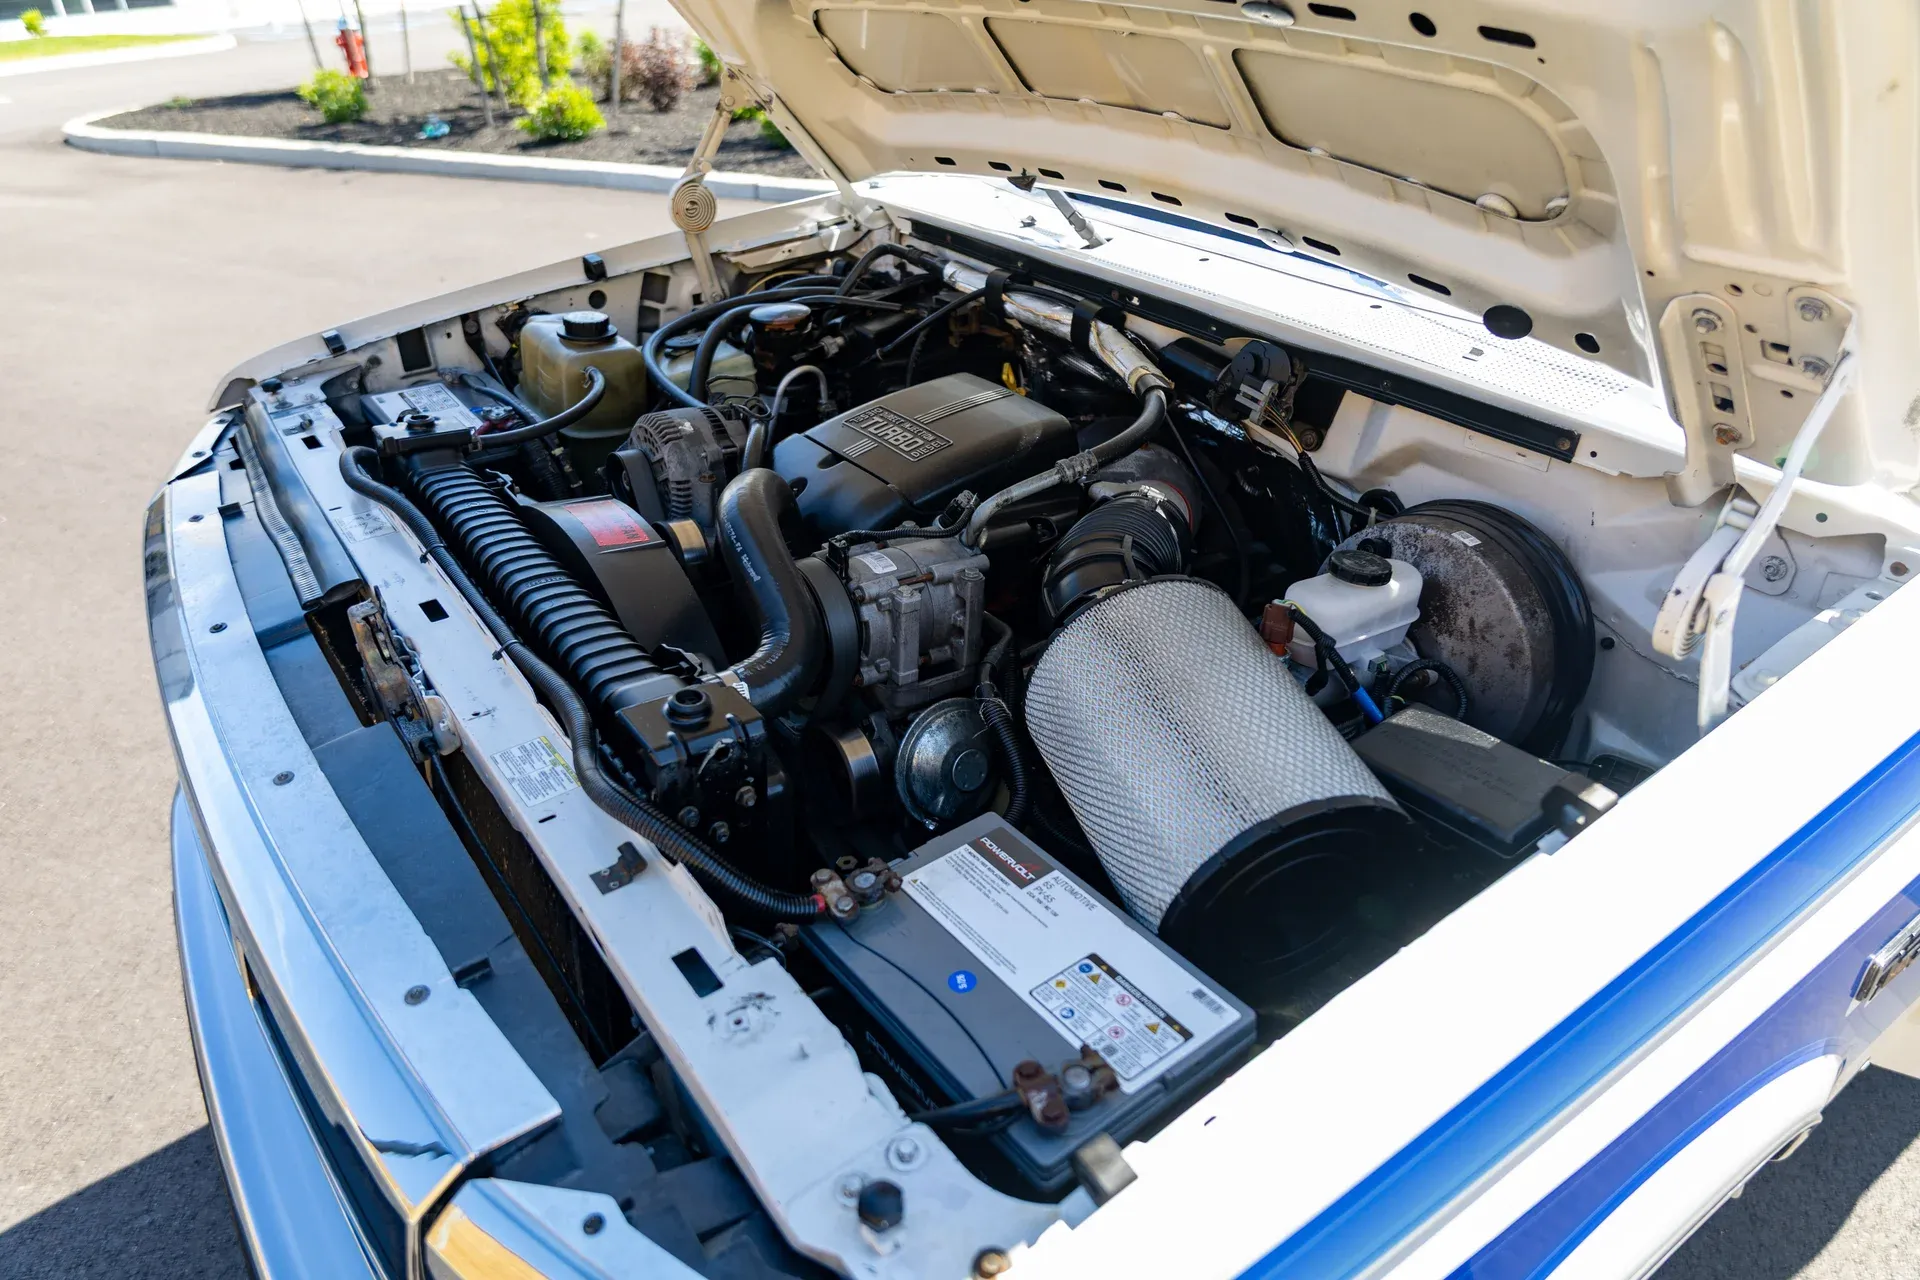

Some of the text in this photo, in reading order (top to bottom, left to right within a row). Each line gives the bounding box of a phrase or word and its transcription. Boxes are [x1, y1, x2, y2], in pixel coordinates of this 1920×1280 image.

[861, 416, 925, 452] TURBO
[911, 440, 946, 458] DIESEL
[980, 836, 1036, 881] POWERVOLT
[1033, 885, 1056, 904] PV-65
[1042, 879, 1055, 891] 65
[1051, 875, 1098, 912] AUTOMOTIVE
[865, 1031, 939, 1111] POWERVO
